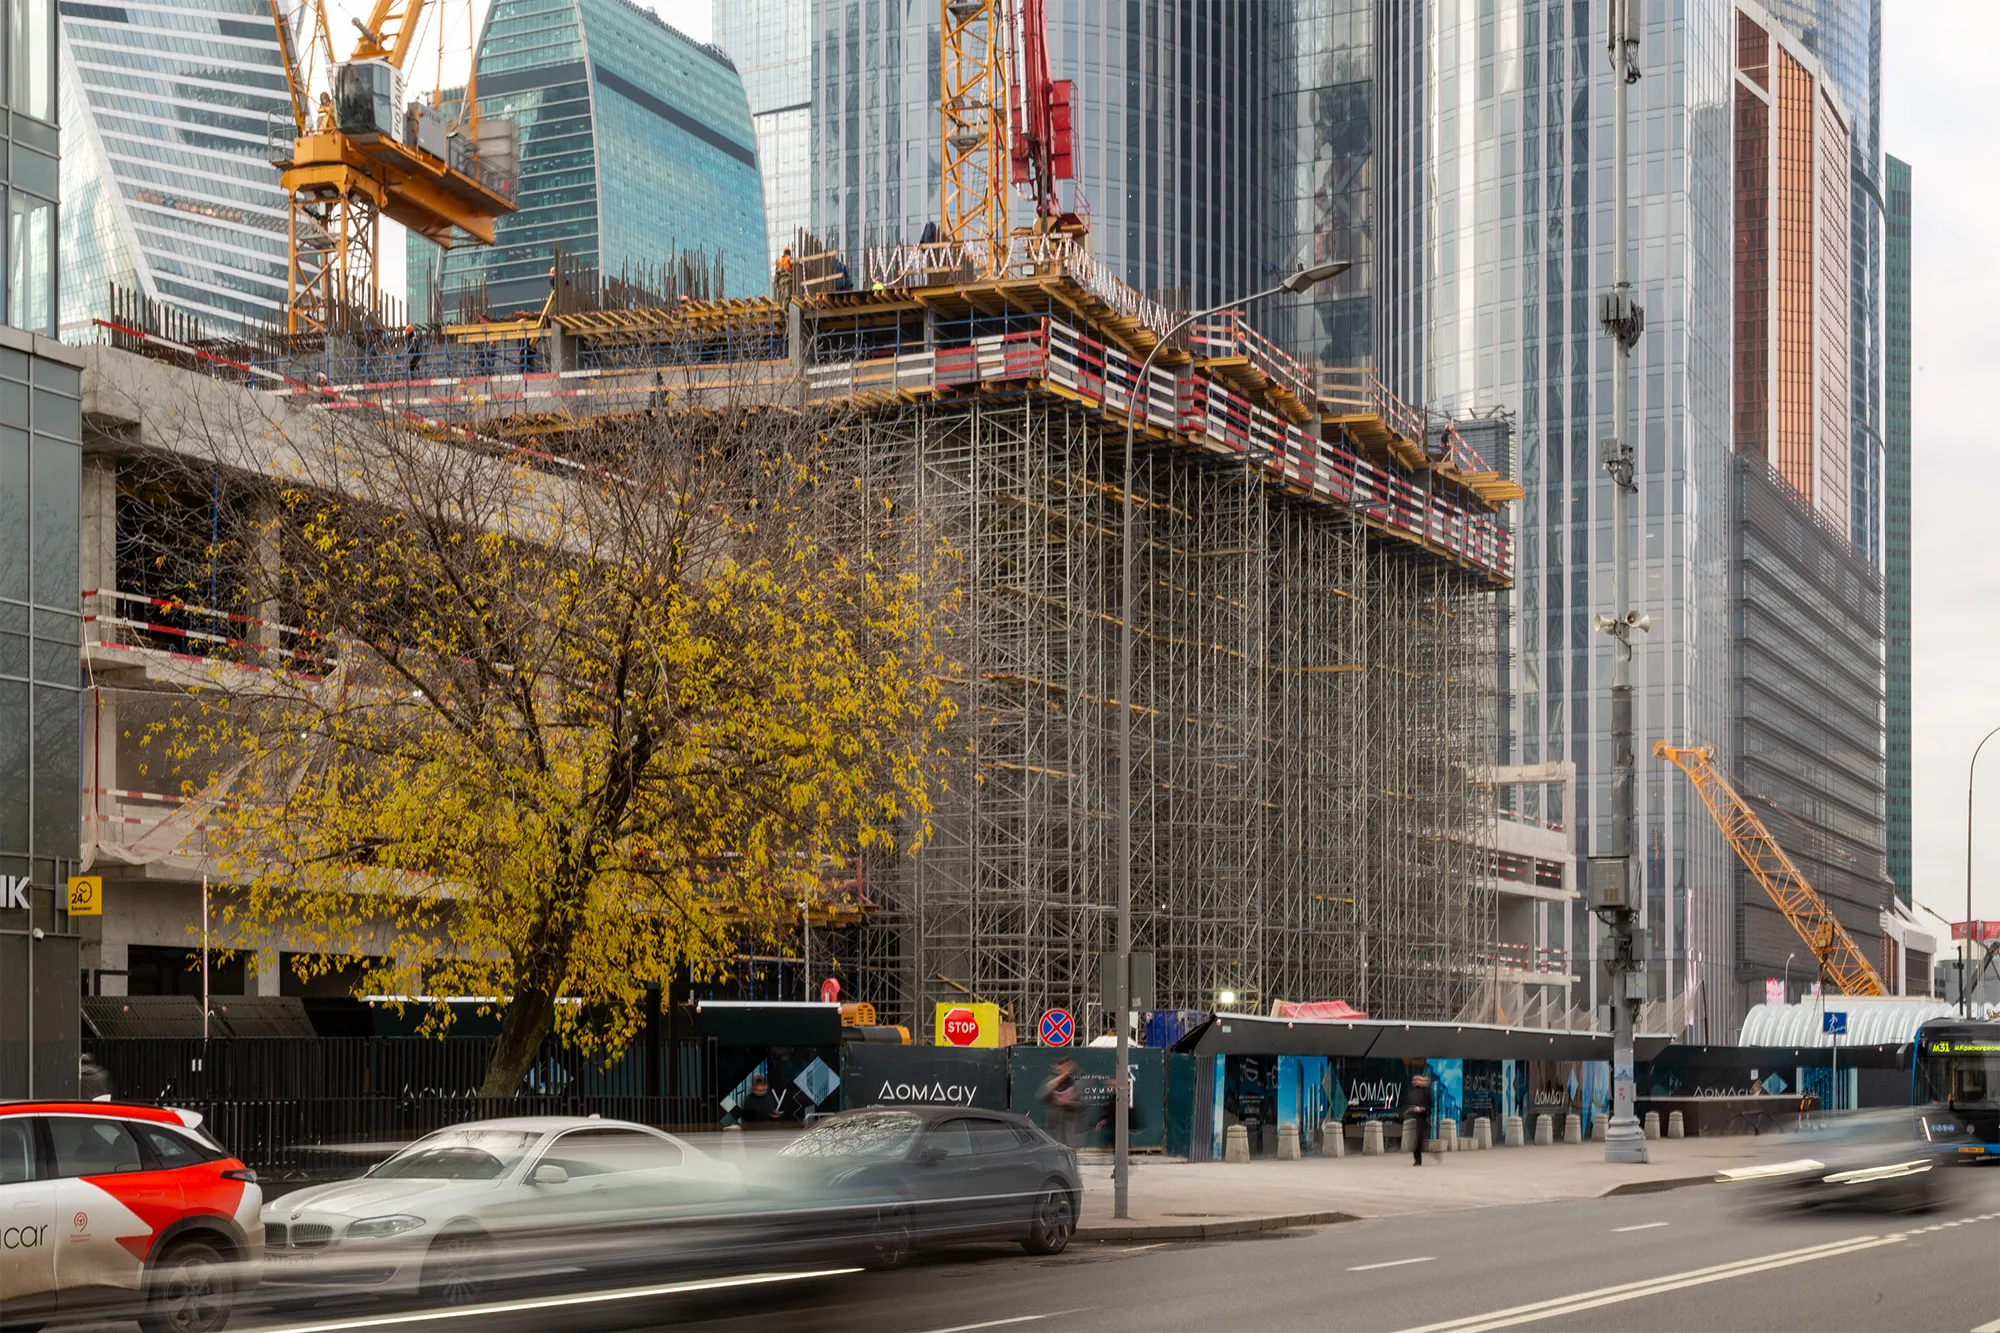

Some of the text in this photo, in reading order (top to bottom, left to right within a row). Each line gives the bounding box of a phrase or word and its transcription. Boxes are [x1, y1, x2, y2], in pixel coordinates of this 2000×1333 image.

[393, 75, 403, 135] POTAIN
[71, 893, 83, 904] 24
[947, 1021, 976, 1033] STOP
[0, 1224, 48, 1250] car
